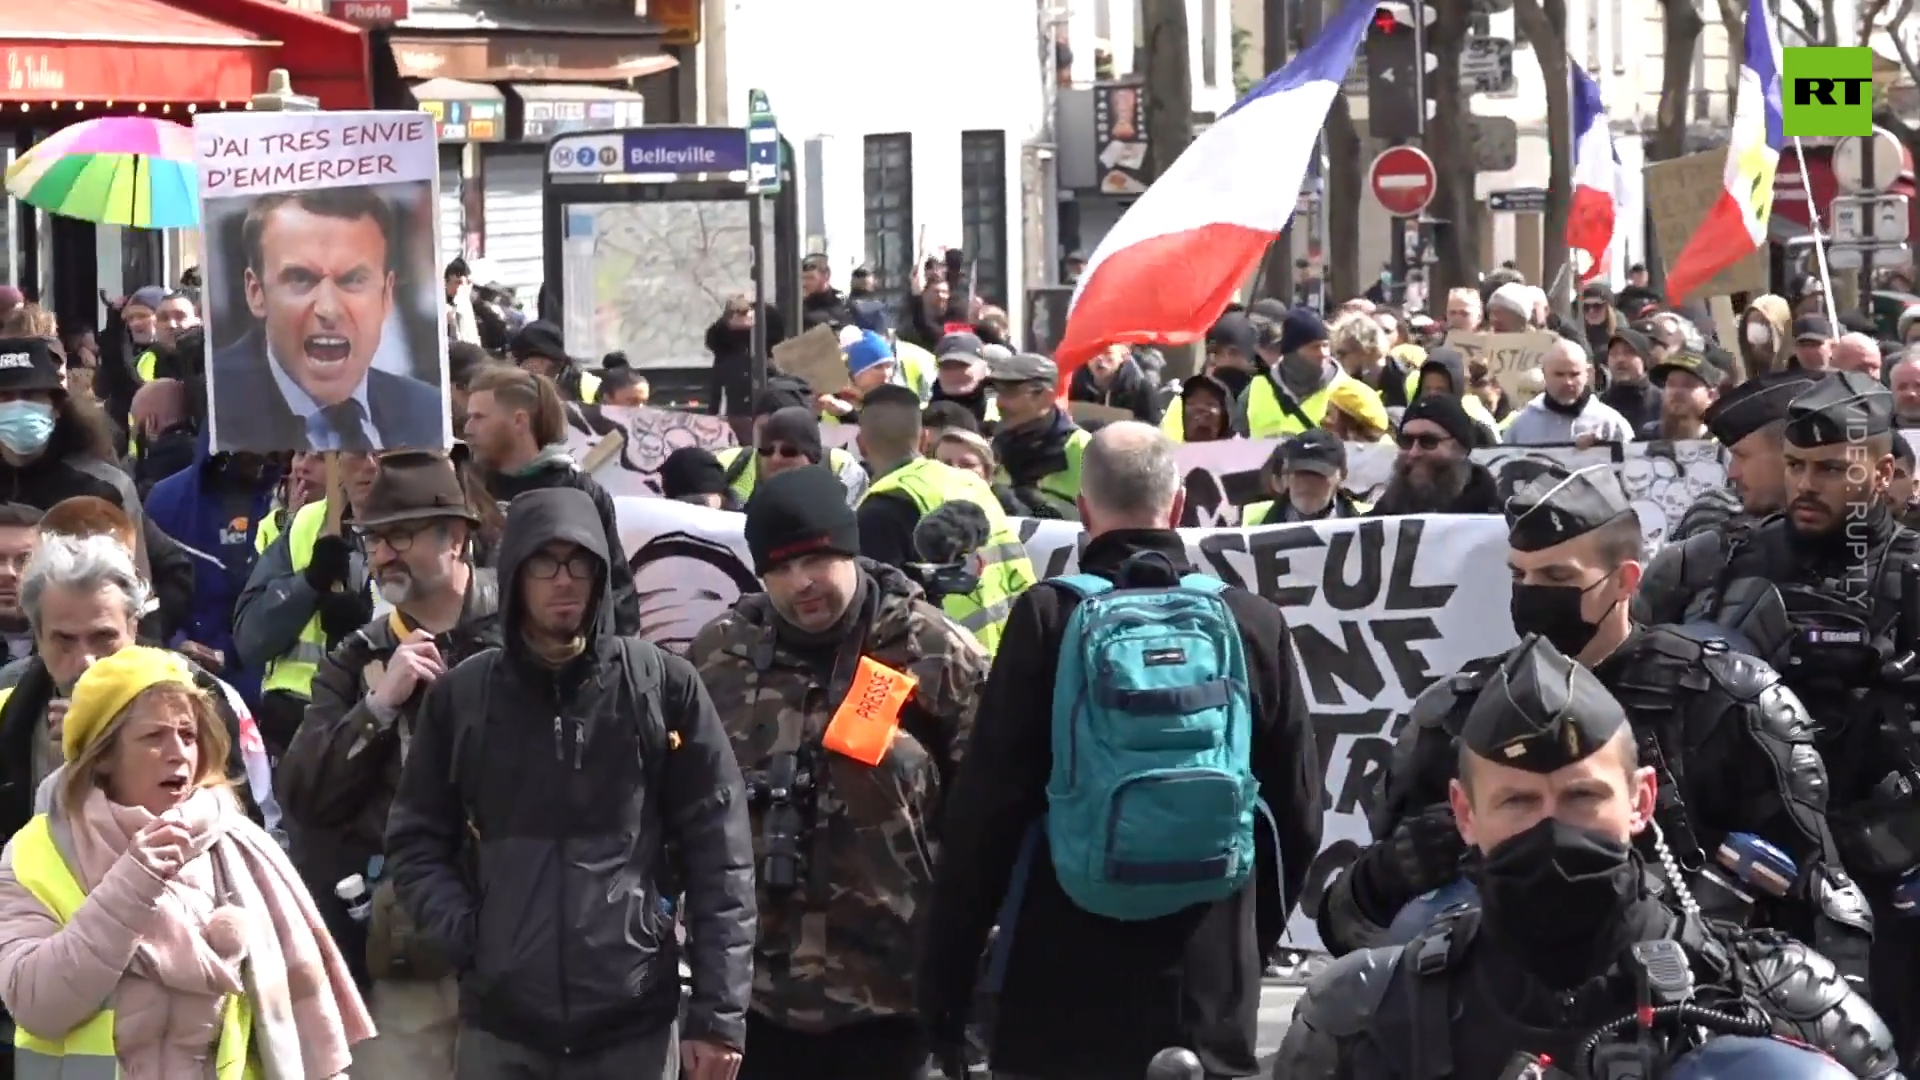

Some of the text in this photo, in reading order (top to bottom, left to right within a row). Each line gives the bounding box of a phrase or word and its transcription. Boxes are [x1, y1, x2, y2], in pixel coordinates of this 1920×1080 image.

[344, 3, 392, 19] Photo
[204, 137, 249, 157] J'AI
[259, 129, 330, 154] TRES
[342, 121, 424, 146] ENVIE
[631, 147, 716, 164] Belleville
[207, 154, 398, 188] D'EMMERDER
[1199, 519, 1458, 610] SEUL
[855, 670, 894, 722] PRESSE
